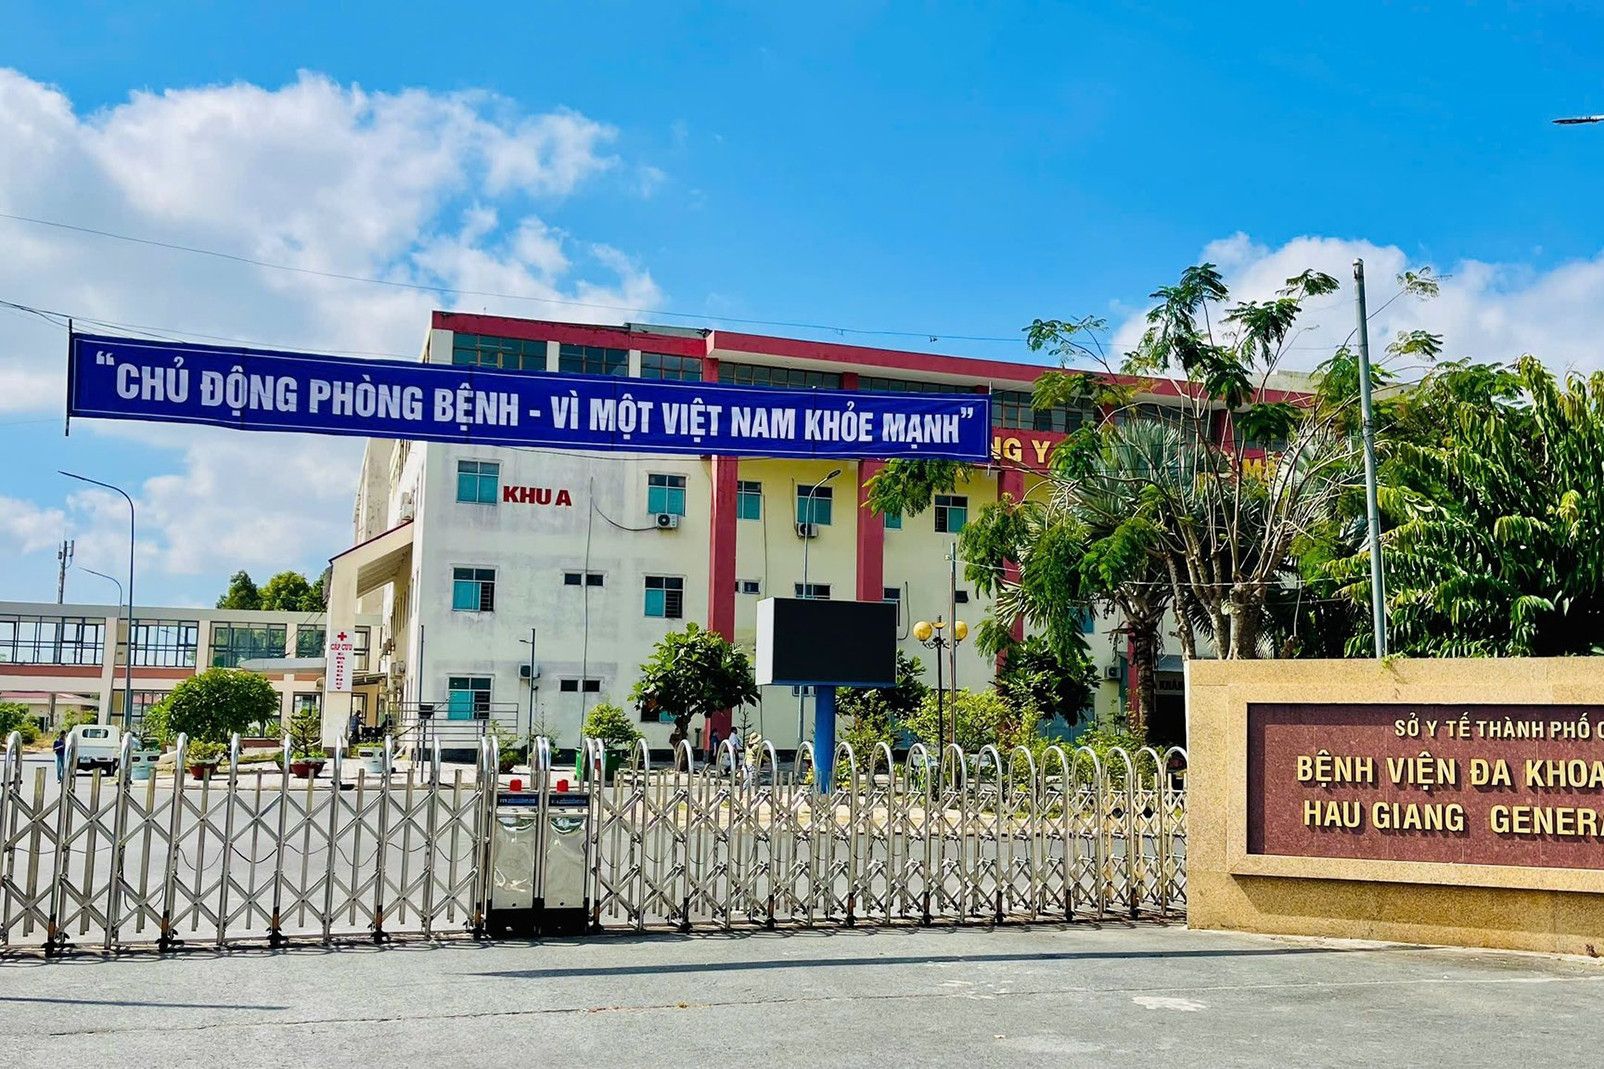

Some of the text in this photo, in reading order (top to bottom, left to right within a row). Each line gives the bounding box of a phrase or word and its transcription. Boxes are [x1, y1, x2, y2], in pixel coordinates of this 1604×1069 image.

[199, 365, 298, 416] ĐỘNG
[309, 374, 423, 421] PHÒNG
[434, 383, 520, 431] BỆNH
[550, 390, 580, 430] VÌ
[589, 393, 653, 440] MỘT
[661, 397, 722, 443] VIỆT
[730, 406, 795, 440] NAM
[804, 401, 874, 443] KHỎE
[1031, 440, 1051, 464] Y
[503, 485, 572, 506] KHU A
[1394, 711, 1420, 738] SỞ
[1426, 719, 1439, 738] Y
[1446, 711, 1471, 738] TẾ
[1476, 715, 1545, 739] THÀNH
[1550, 712, 1591, 739] PHỐ
[1296, 749, 1604, 791] BỆNH VIỆN ĐA KHOA
[1371, 801, 1465, 832] GIANG
[1490, 804, 1604, 838] GENER
